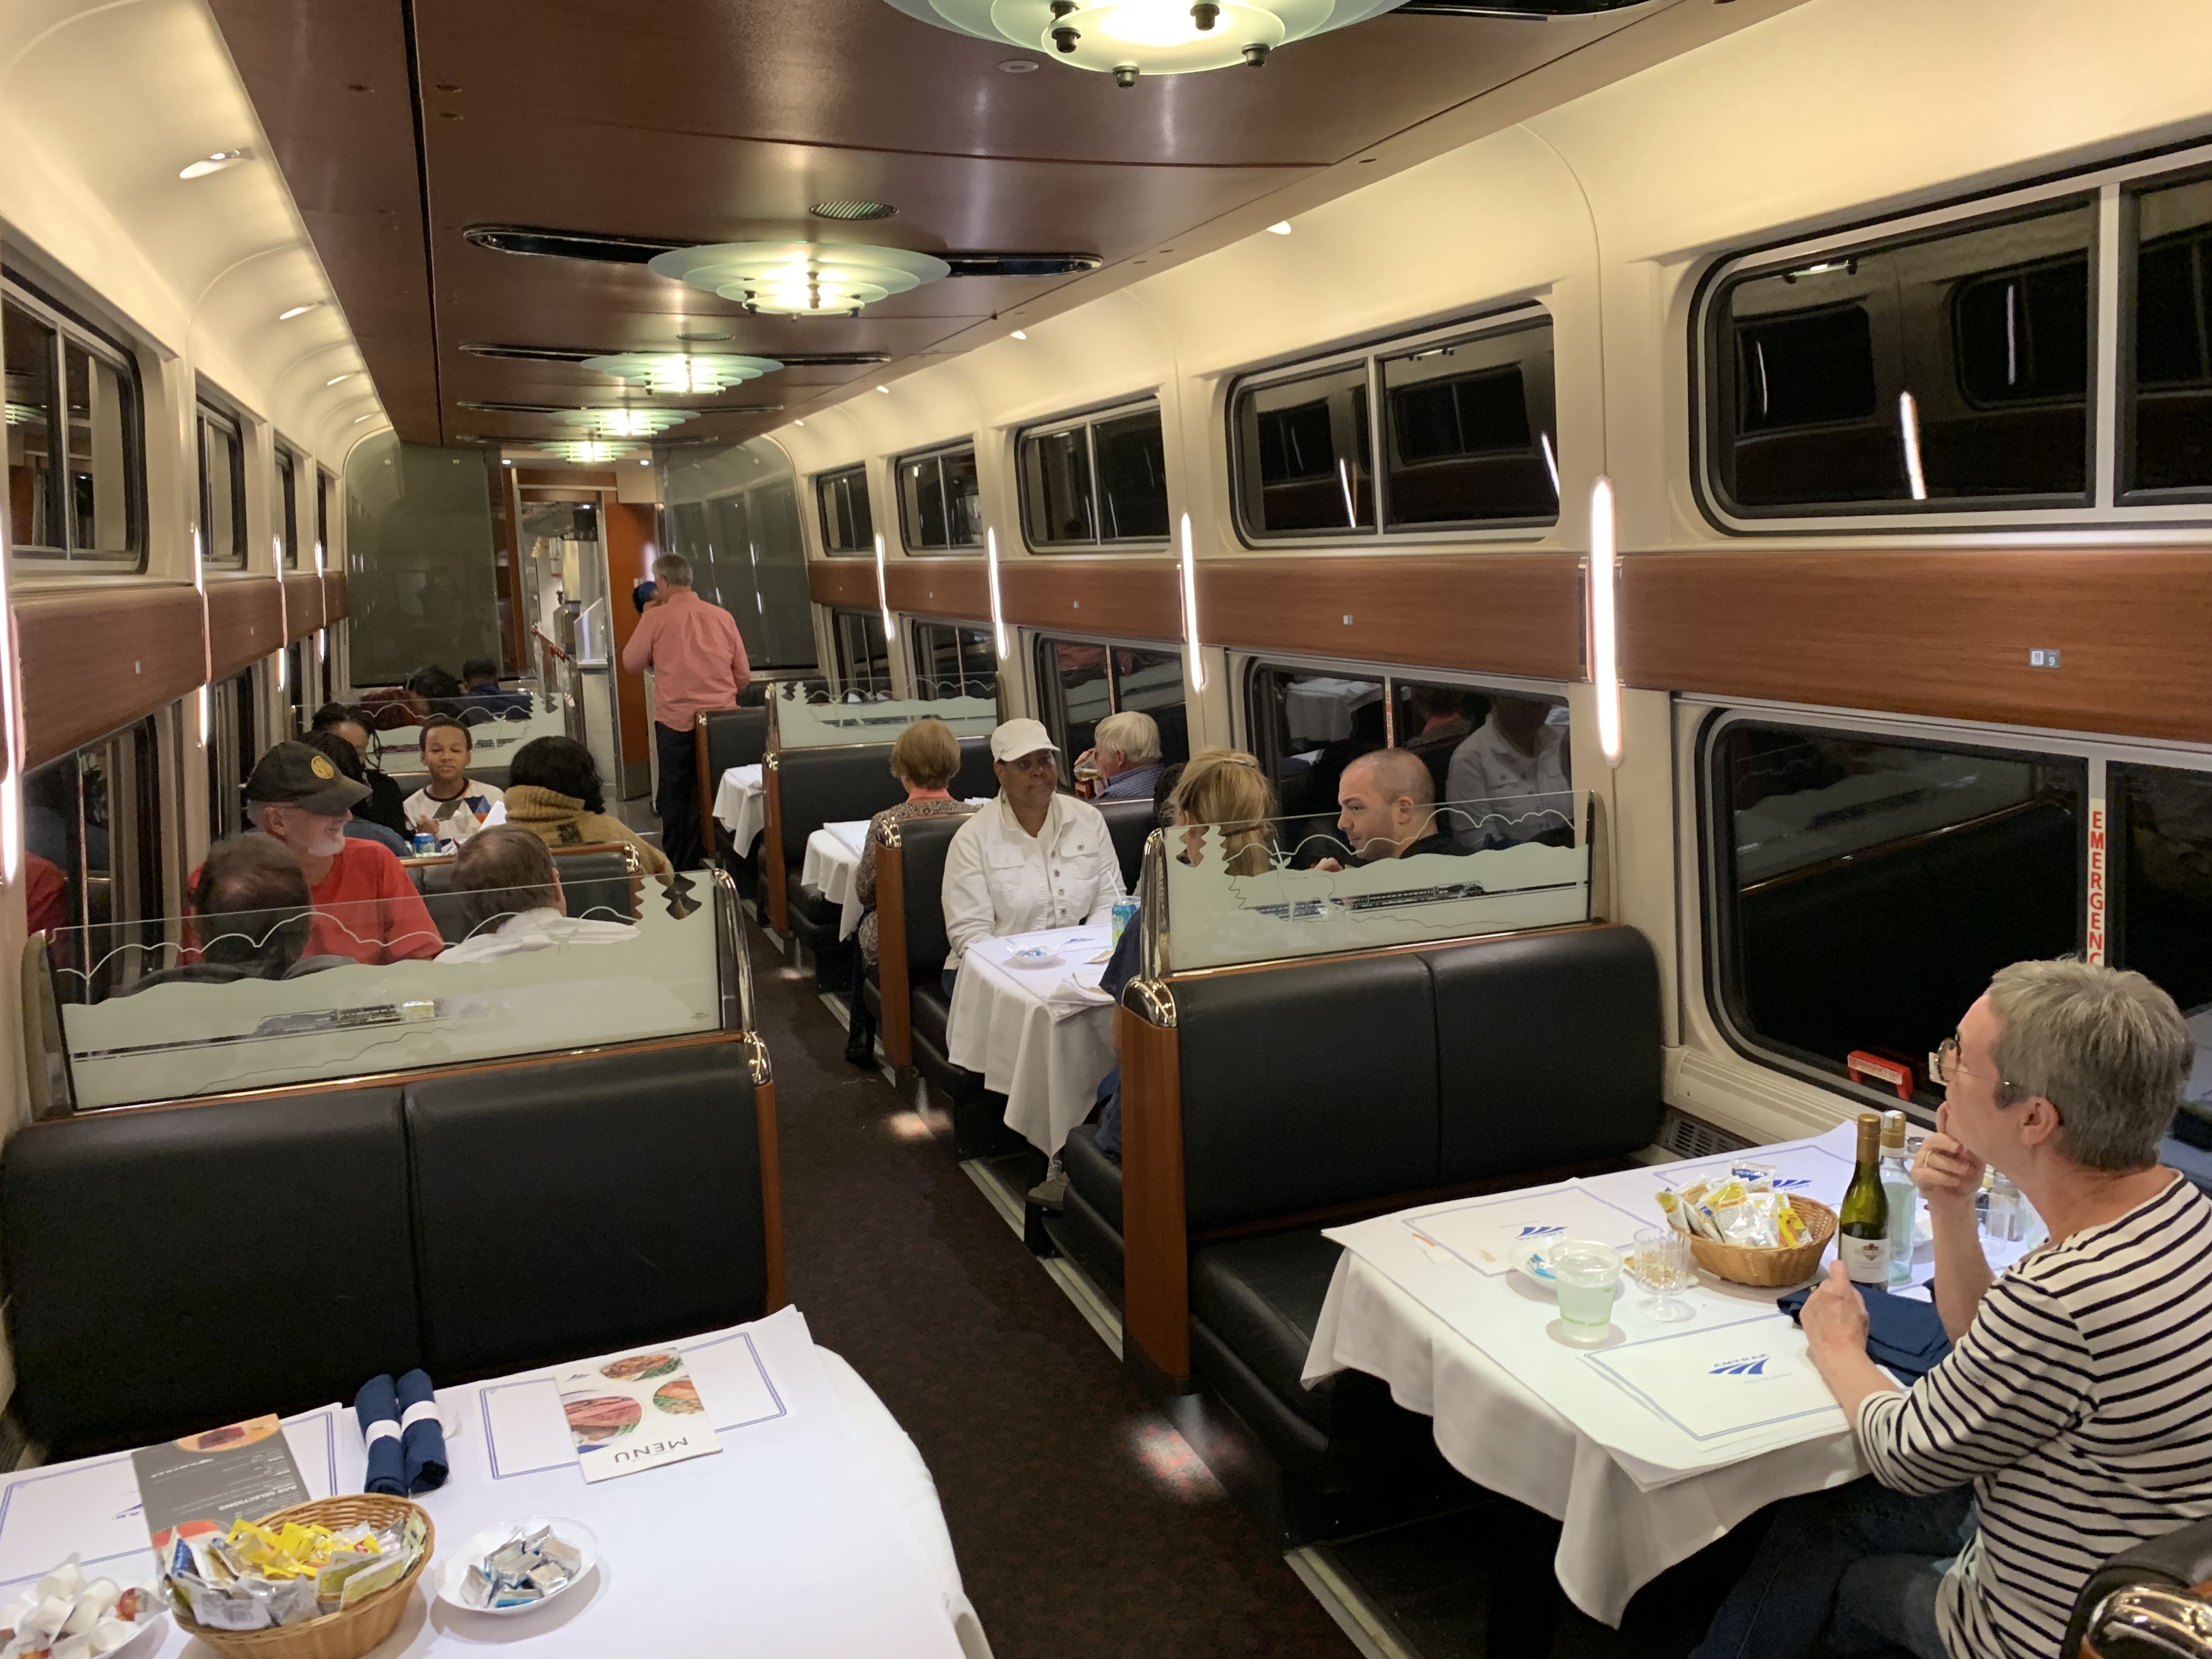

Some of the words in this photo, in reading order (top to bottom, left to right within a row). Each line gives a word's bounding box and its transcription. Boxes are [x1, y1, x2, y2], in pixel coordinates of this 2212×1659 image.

[614, 1437, 689, 1463] MENU
[217, 1489, 275, 1511] SELECTIONS
[276, 1484, 297, 1494] BAR
